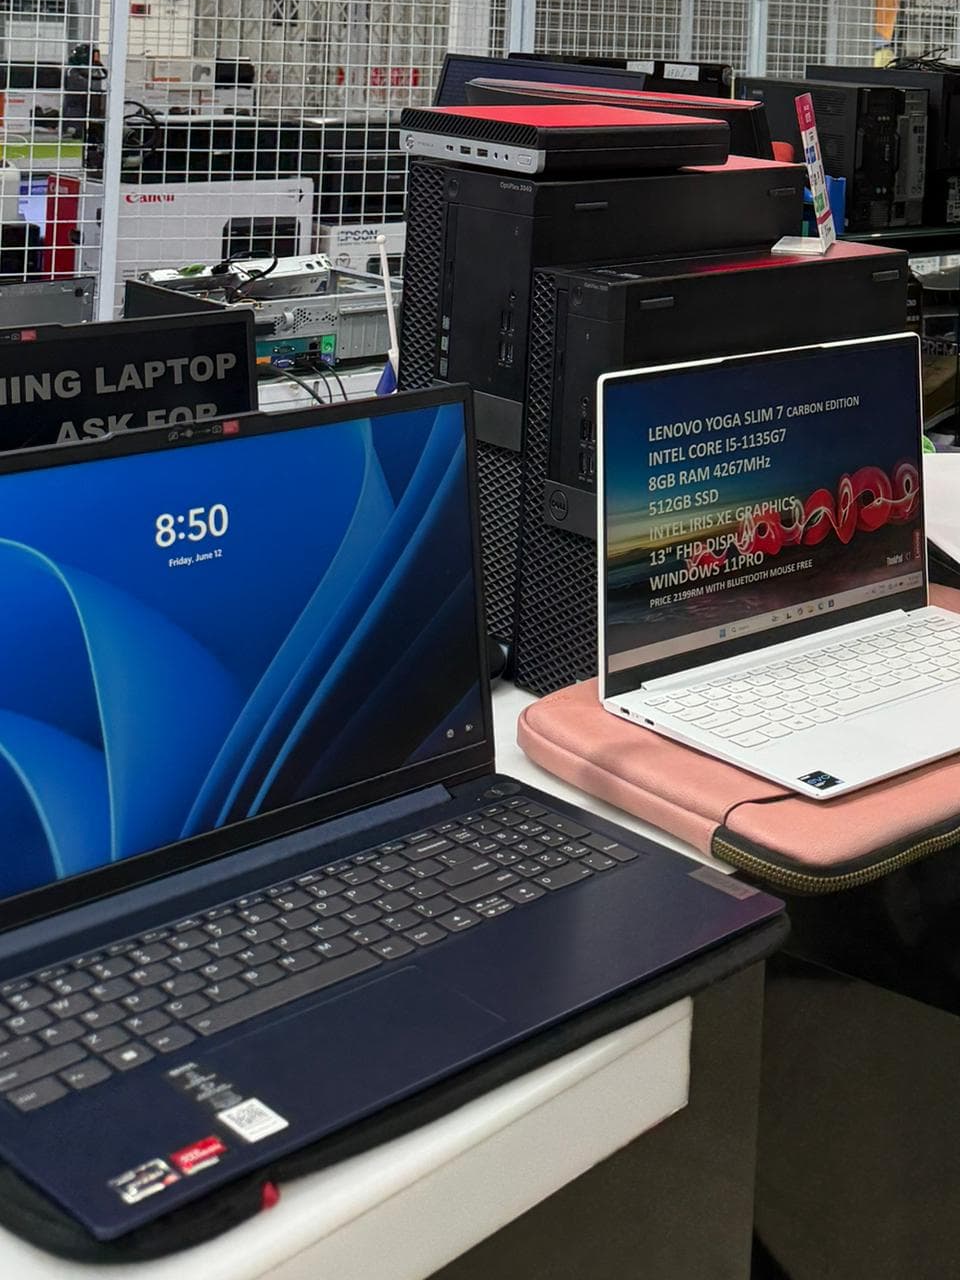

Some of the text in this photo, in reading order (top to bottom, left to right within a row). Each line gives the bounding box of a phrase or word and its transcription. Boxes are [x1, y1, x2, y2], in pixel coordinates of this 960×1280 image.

[125, 192, 175, 204] Canon
[338, 229, 378, 242] EPSON
[95, 353, 237, 395] LAPTOP
[56, 412, 134, 445] ASK
[648, 395, 860, 442] LENOVO YOGA SLIM 7 CARBON EDITION
[648, 428, 788, 467] INTEL CORE I5-1135G7
[648, 454, 772, 492] 8GB RAM 4267MHz
[648, 489, 720, 517] 512GB SSD
[649, 495, 796, 542] INTEL IRIS XE GRAPHICS
[155, 503, 229, 548] 8:50
[676, 540, 704, 561] FHD
[706, 528, 756, 552] DISPLAY
[168, 549, 223, 568] Friday, June 12
[650, 551, 764, 592] WINDOWS 11PRO
[650, 558, 813, 608] PRICE 2199RM WITH BLUETOOTH MOUSE FREE
